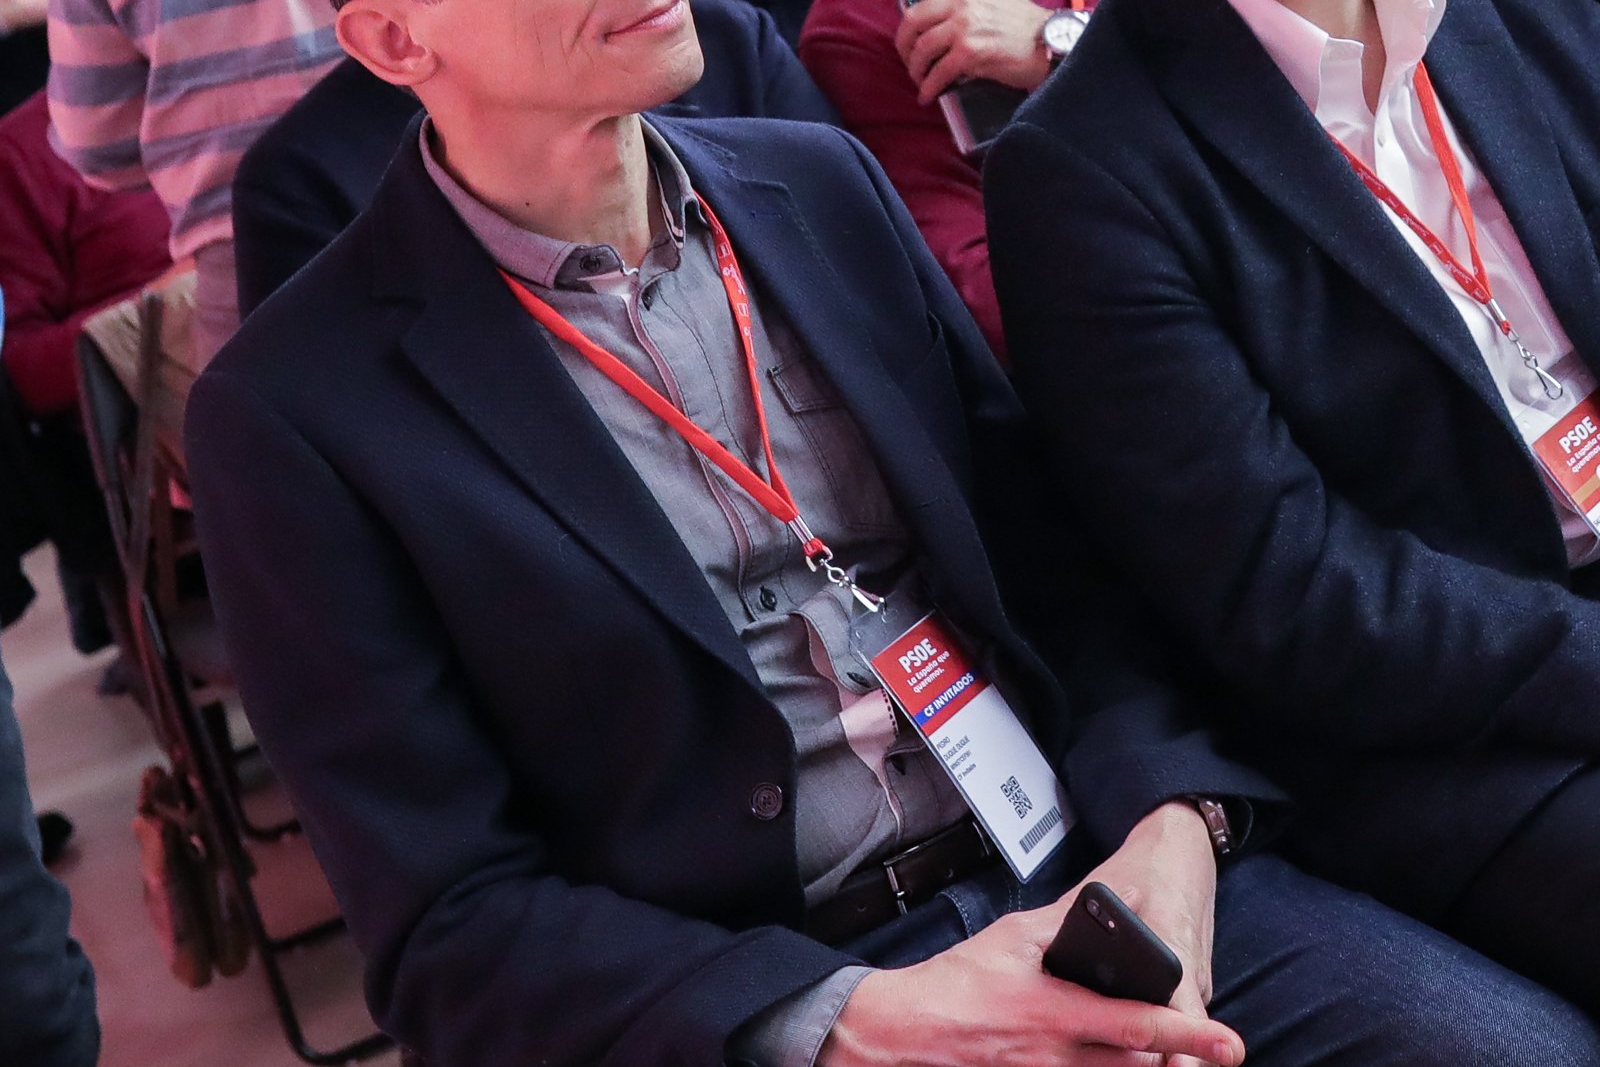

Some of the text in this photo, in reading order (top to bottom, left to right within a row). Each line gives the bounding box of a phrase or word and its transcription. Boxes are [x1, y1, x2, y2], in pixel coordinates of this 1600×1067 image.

[1559, 415, 1597, 454] PSOE
[1566, 456, 1576, 467] La
[1574, 437, 1598, 460] España
[898, 637, 937, 673] PSOE
[906, 650, 950, 686] La España que
[923, 672, 974, 717] CF INVITADOS
